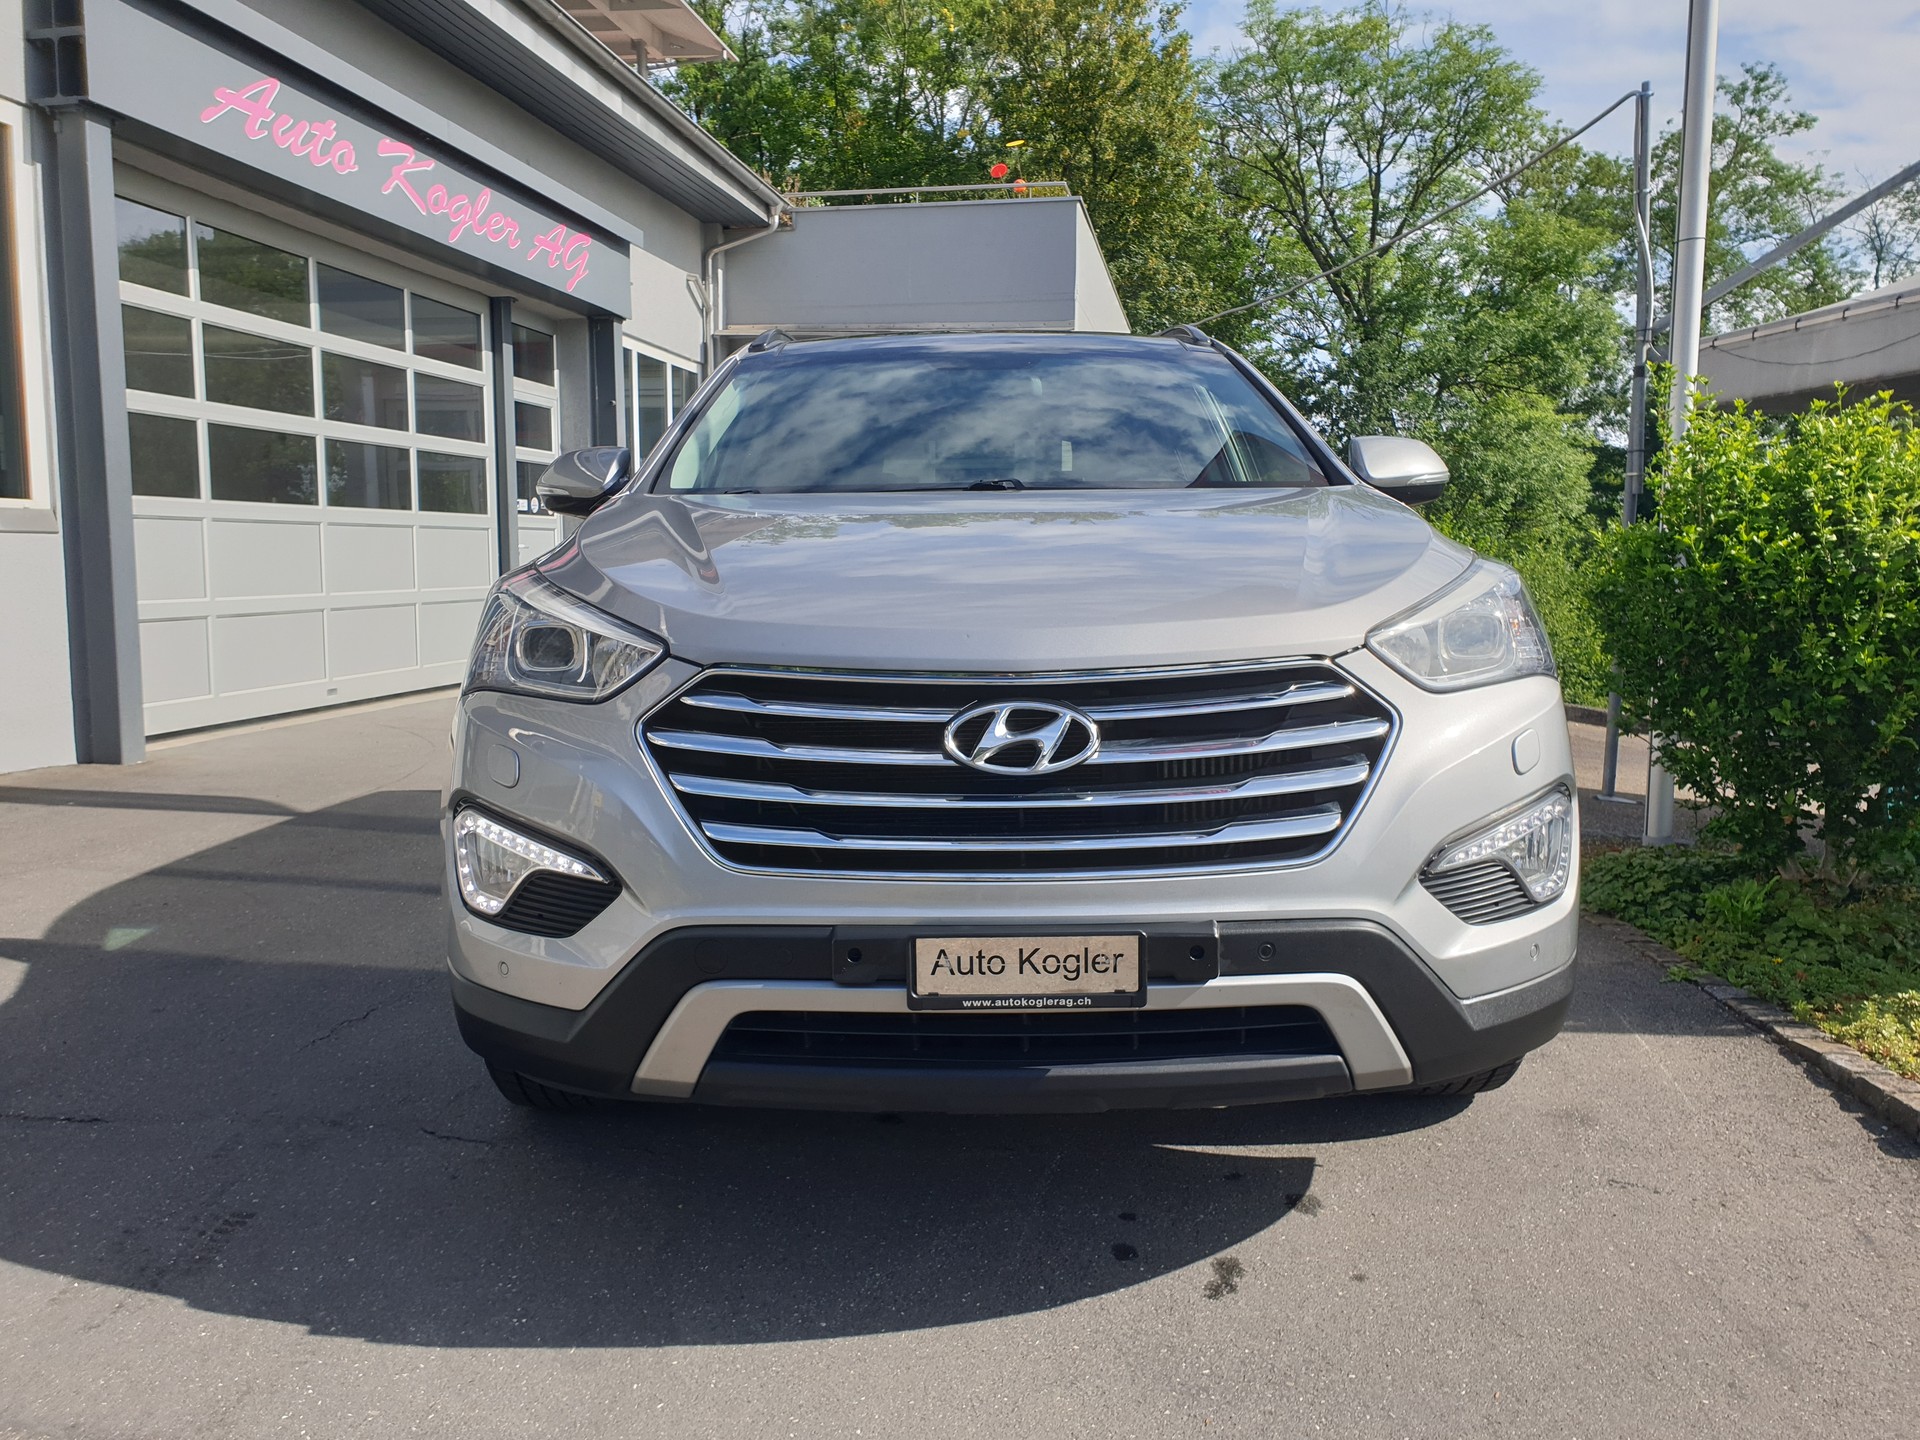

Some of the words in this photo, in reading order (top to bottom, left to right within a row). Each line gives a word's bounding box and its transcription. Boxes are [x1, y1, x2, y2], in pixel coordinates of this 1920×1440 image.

[200, 76, 359, 175] Auto
[377, 137, 521, 249] Kogler
[527, 223, 593, 292] AG
[930, 948, 1006, 976] Auto
[1018, 947, 1125, 982] Kogler
[962, 996, 1092, 1008] www.autokoglerag.ch
